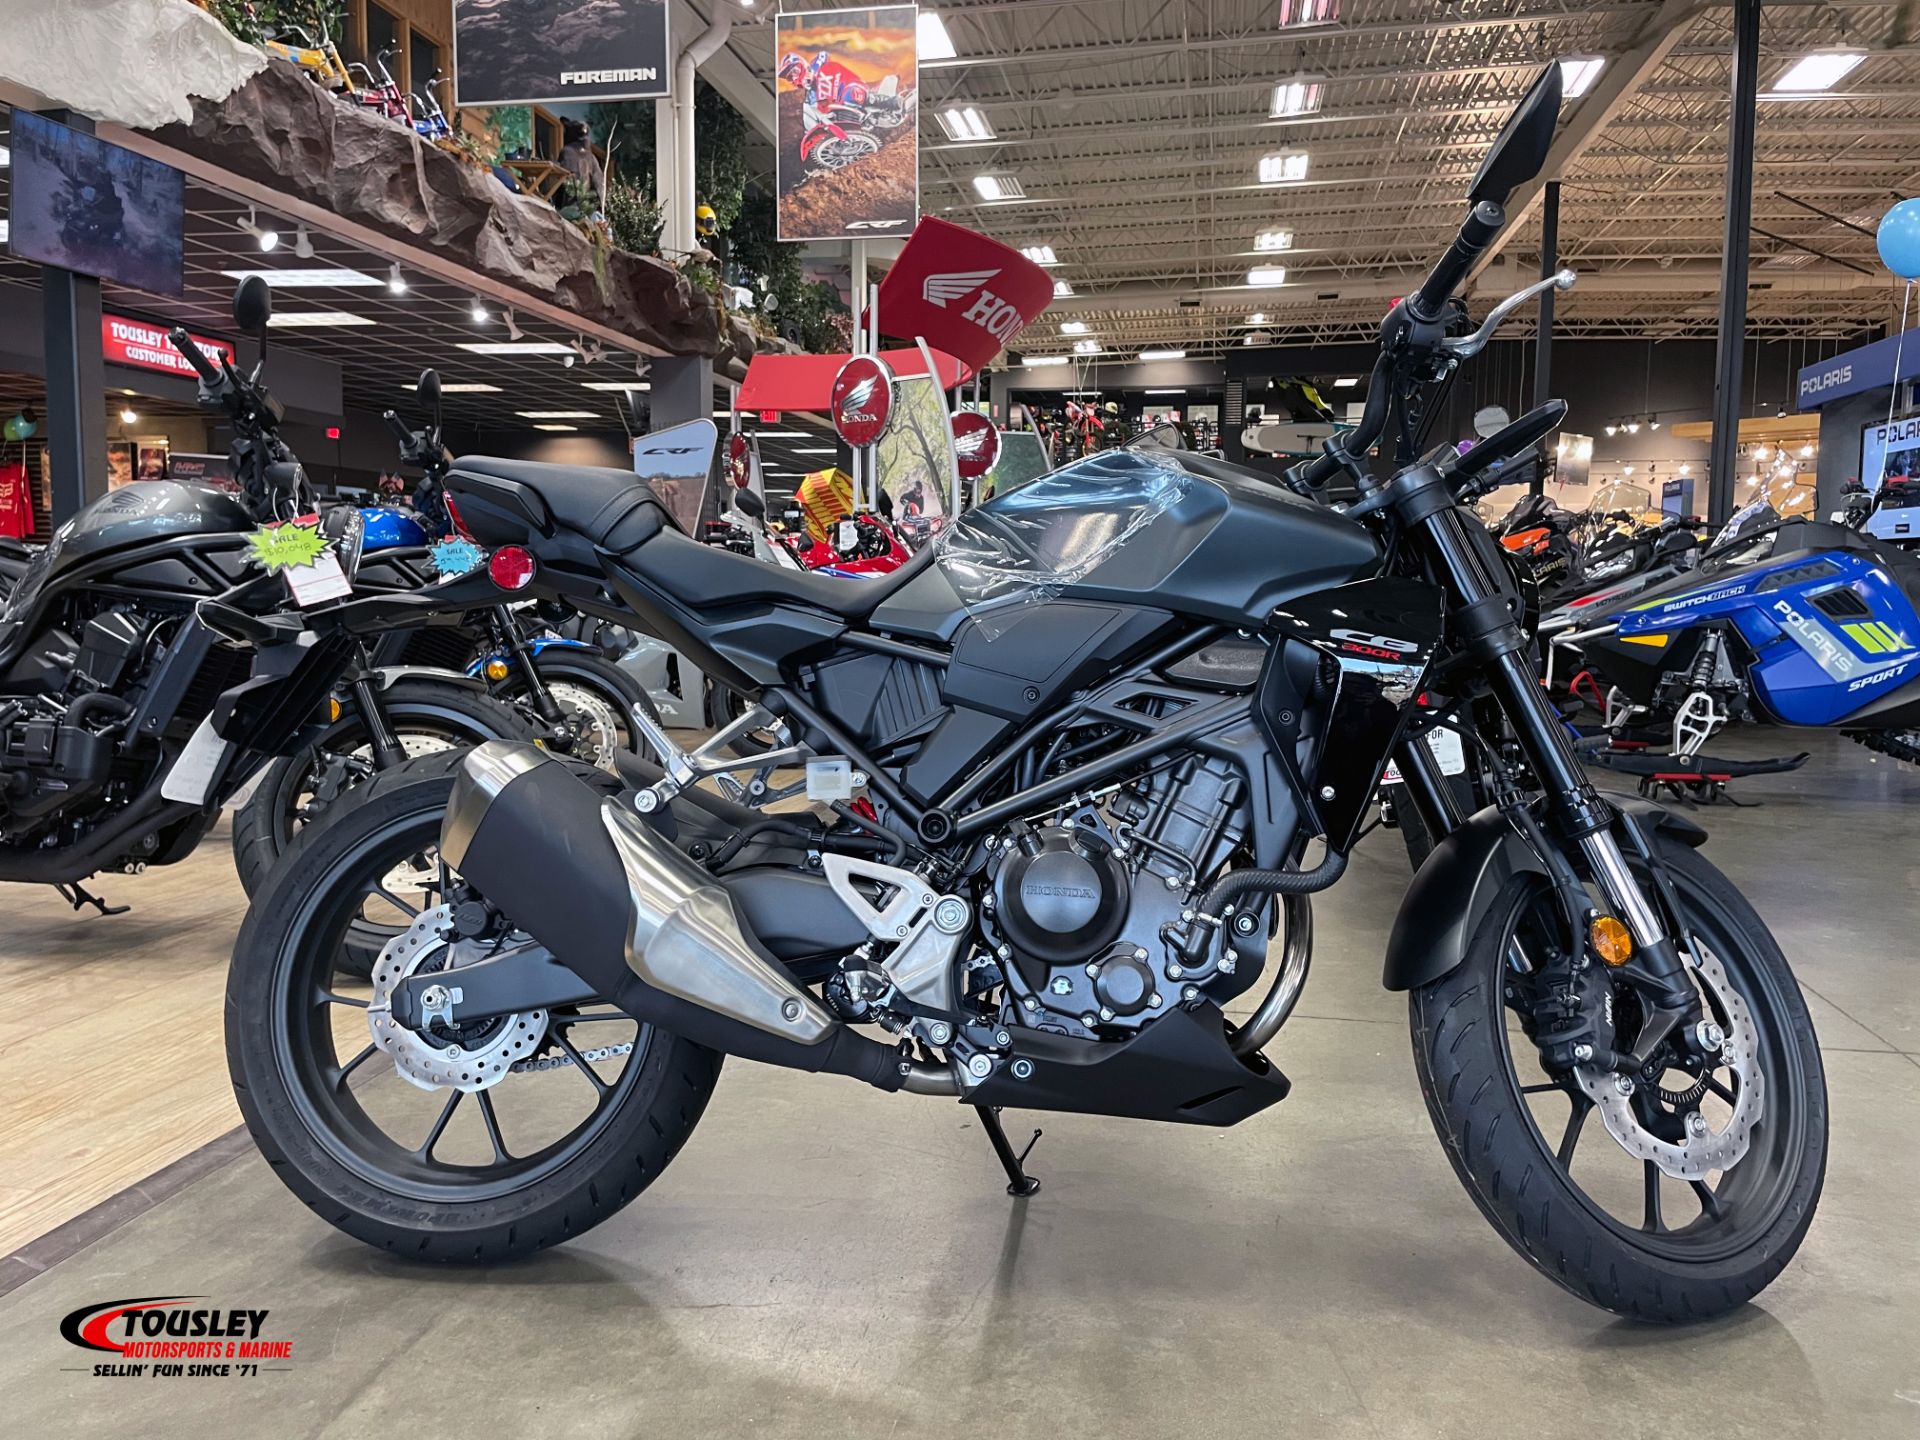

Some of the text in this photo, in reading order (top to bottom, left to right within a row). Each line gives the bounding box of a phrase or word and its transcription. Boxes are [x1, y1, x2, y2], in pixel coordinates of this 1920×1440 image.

[561, 67, 656, 85] FOREMAN
[845, 220, 907, 229] CRF
[961, 290, 1024, 349] HON
[111, 322, 162, 348] TOUSLEY
[126, 346, 176, 369] CUSTOMER
[1800, 365, 1852, 396] POLARIS
[642, 447, 704, 455] CRF
[1663, 585, 1747, 613] SWITCHBACK
[1329, 628, 1419, 653] CB
[1773, 600, 1853, 672] POLARIS
[1341, 641, 1401, 661] 300R
[1847, 663, 1909, 692] SPORT
[1025, 885, 1097, 899] HONDA
